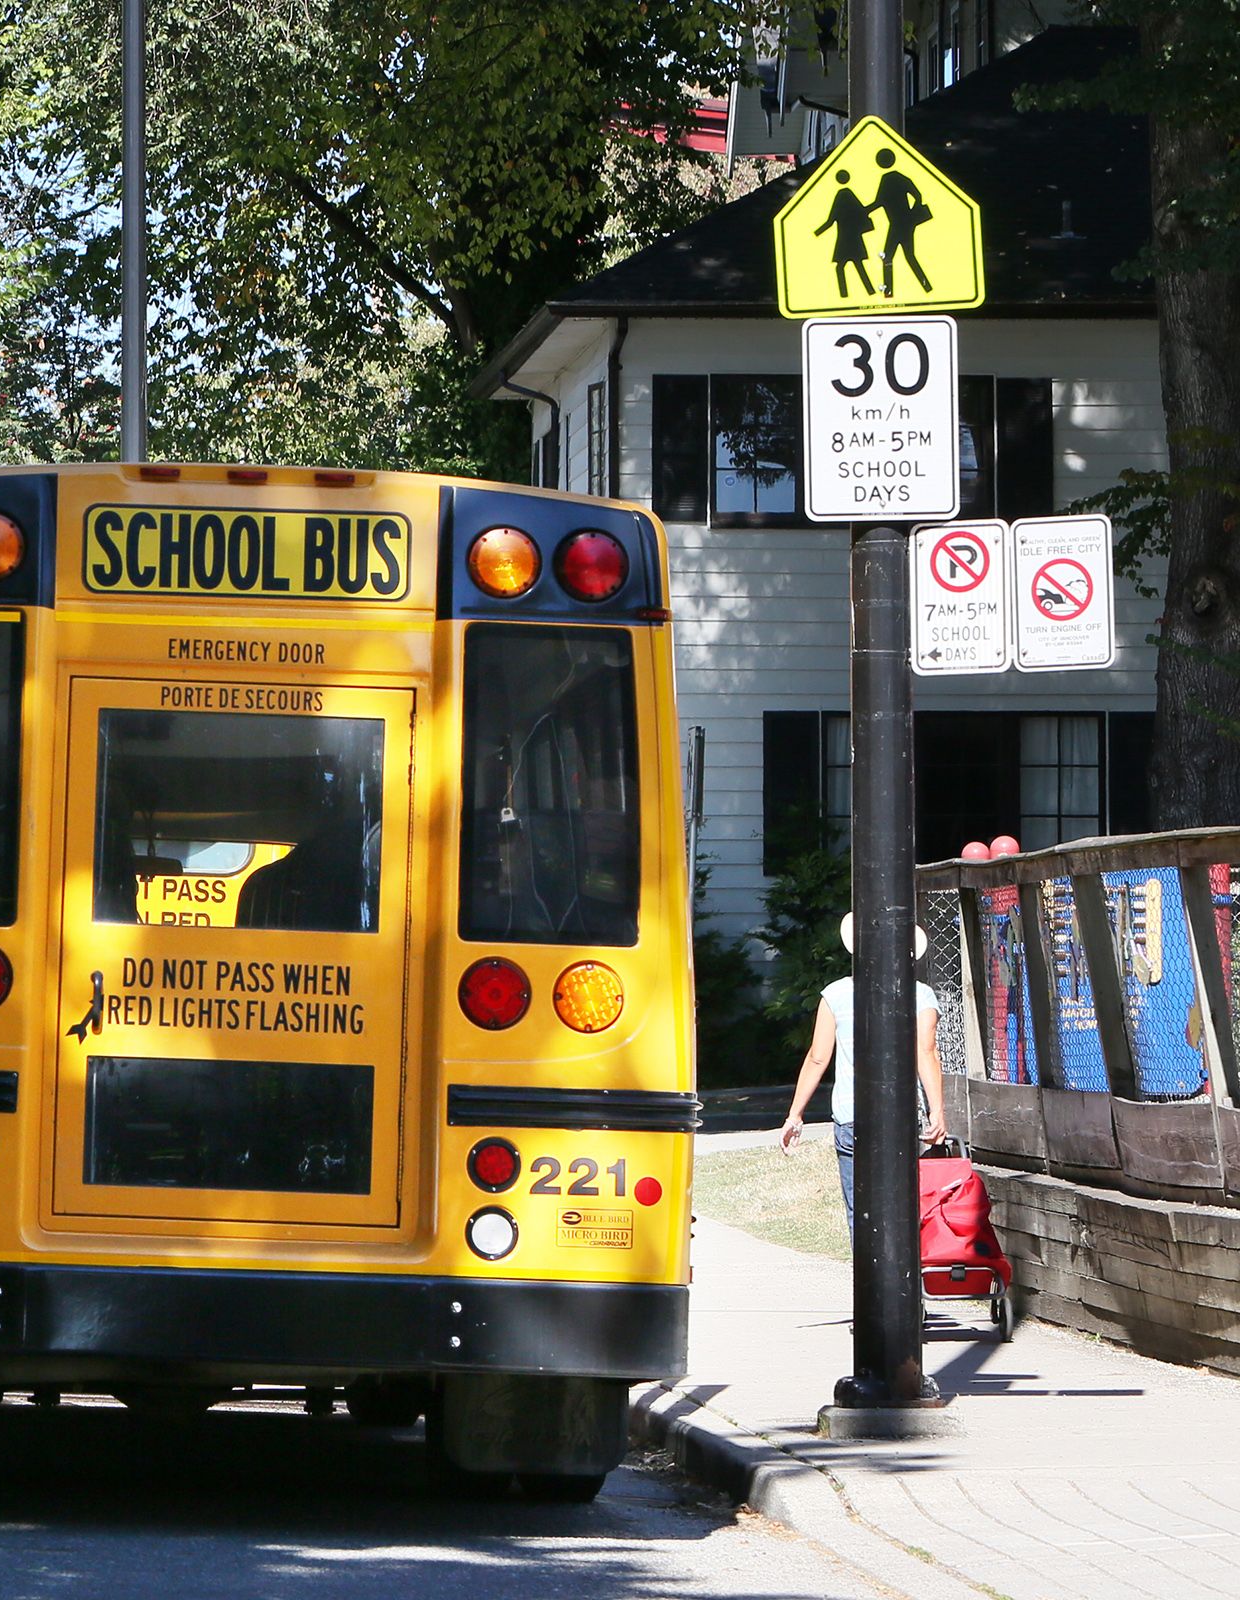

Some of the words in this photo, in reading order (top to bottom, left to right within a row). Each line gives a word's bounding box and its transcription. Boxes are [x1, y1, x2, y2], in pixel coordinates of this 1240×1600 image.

[831, 333, 929, 397] 30
[852, 403, 909, 421] km/h
[838, 460, 926, 478] SCHOOL
[854, 485, 910, 502] DAYS
[92, 510, 290, 591] SCHOOL
[303, 517, 401, 595] BUS
[1020, 547, 1042, 557] IDLE
[1047, 545, 1073, 555] FREE
[1077, 543, 1101, 553] CITY
[932, 626, 990, 642] SCHOOL
[1025, 626, 1048, 634] TURN
[1051, 624, 1082, 633] ENGINE
[1085, 622, 1102, 631] OFF
[168, 638, 271, 663] EMERGENCY
[279, 642, 325, 665] DOOR
[946, 647, 977, 661] DAYS
[160, 686, 214, 708] PORTE
[219, 688, 241, 709] DE
[245, 689, 324, 712] SECOURS
[163, 879, 226, 903] PASS
[122, 957, 154, 988] DO
[163, 959, 208, 991] NOT
[216, 961, 274, 993] PASS
[283, 964, 351, 996] WHEN
[107, 995, 152, 1026] RED
[159, 996, 241, 1030] LIGHTS
[245, 1000, 365, 1035] FLASHING
[529, 1156, 627, 1197] 221
[608, 1215, 629, 1223] BIRD
[561, 1229, 598, 1240] MICRO
[601, 1230, 629, 1241] BIRD
